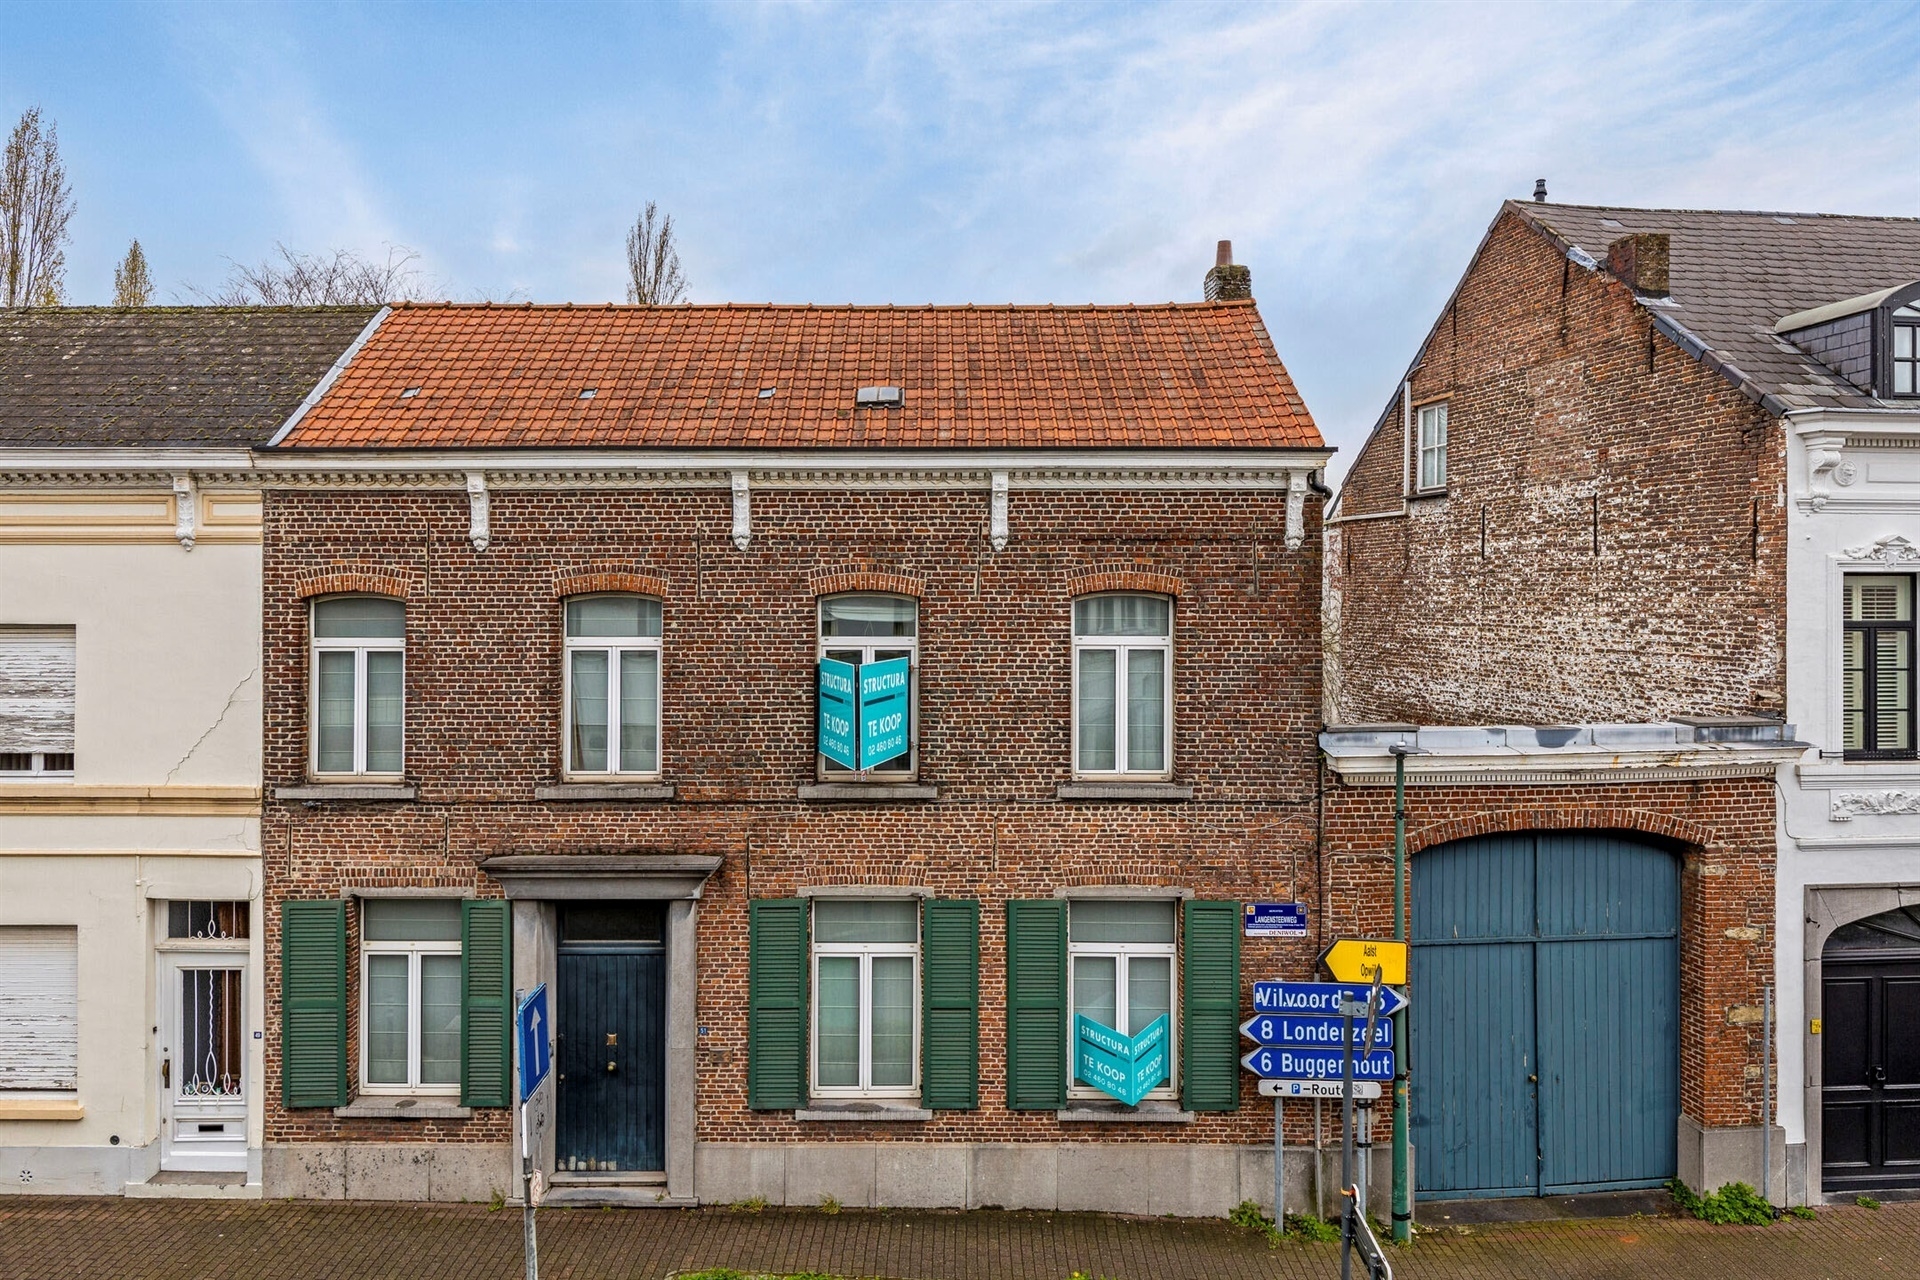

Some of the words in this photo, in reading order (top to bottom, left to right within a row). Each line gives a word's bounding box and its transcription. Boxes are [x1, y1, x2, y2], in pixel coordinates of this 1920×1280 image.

[821, 671, 852, 694] STRUCTURA
[863, 671, 905, 694] STRUCTURA
[823, 712, 830, 730] TE
[831, 717, 849, 737] KOOP
[867, 720, 877, 738] TE
[879, 712, 902, 734] KOOP
[867, 745, 876, 756] 02
[887, 738, 895, 749] 80
[1363, 944, 1377, 957] Aalst
[1361, 963, 1377, 979] Opwij
[1258, 987, 1342, 1009] Vilvoord
[1081, 1025, 1130, 1056] STRUCTURA
[1134, 1025, 1163, 1056] STRUCTURA
[1261, 1019, 1273, 1040] 8
[1083, 1053, 1094, 1069] TE
[1097, 1061, 1126, 1083] KOOP
[1083, 1068, 1092, 1078] 02
[1137, 1071, 1145, 1083] TE
[1145, 1054, 1163, 1075] KOOP
[1261, 1052, 1272, 1072] 6
